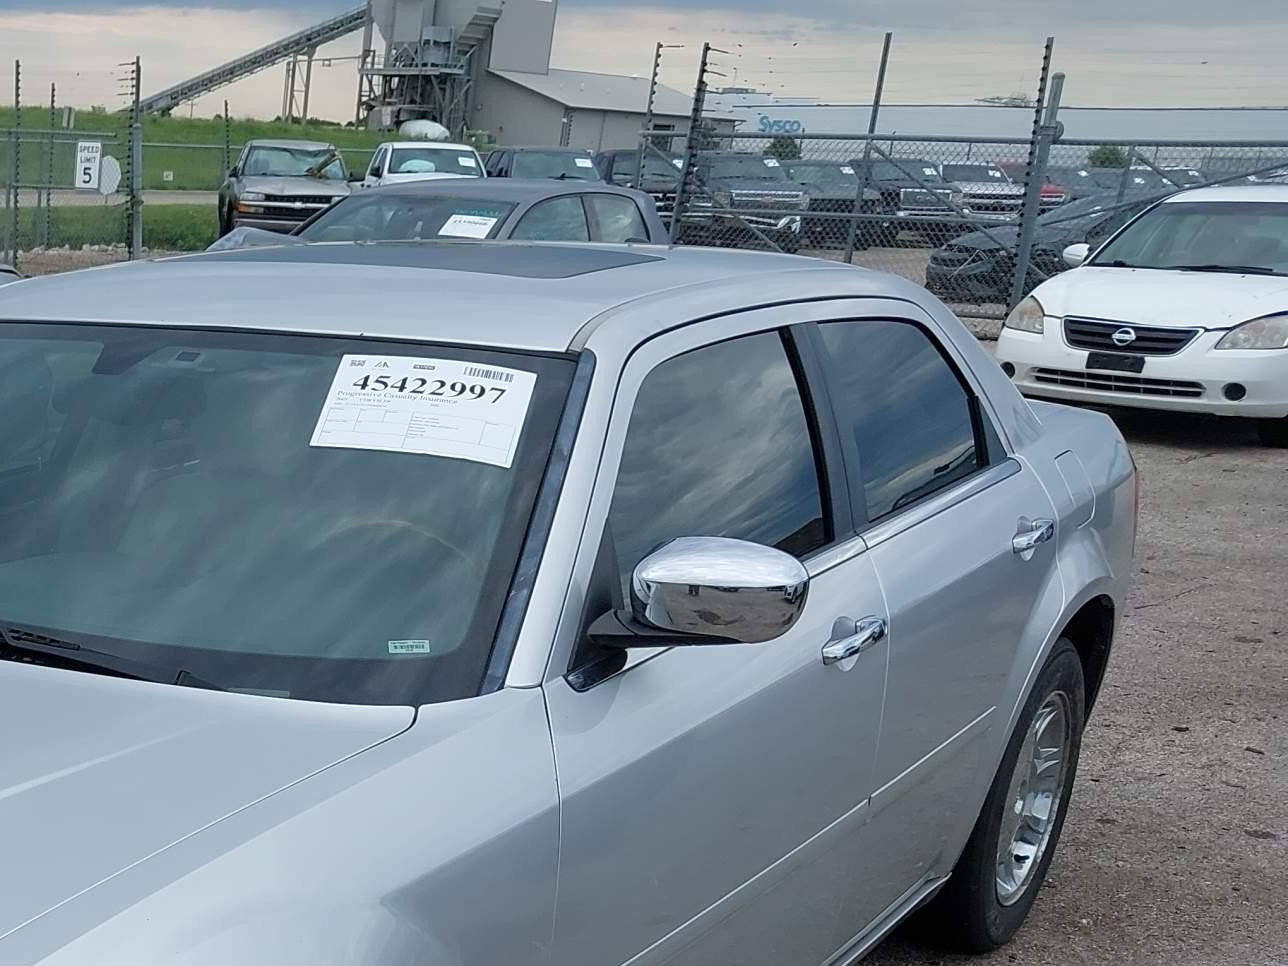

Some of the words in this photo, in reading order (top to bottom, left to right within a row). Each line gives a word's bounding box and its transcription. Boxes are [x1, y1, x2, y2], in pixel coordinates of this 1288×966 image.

[79, 145, 99, 153] SPEED
[82, 167, 92, 184] 5
[352, 374, 507, 404] 45422997
[337, 390, 383, 399] Progressive
[383, 392, 418, 401] Casualty
[419, 395, 458, 404] Insurance
